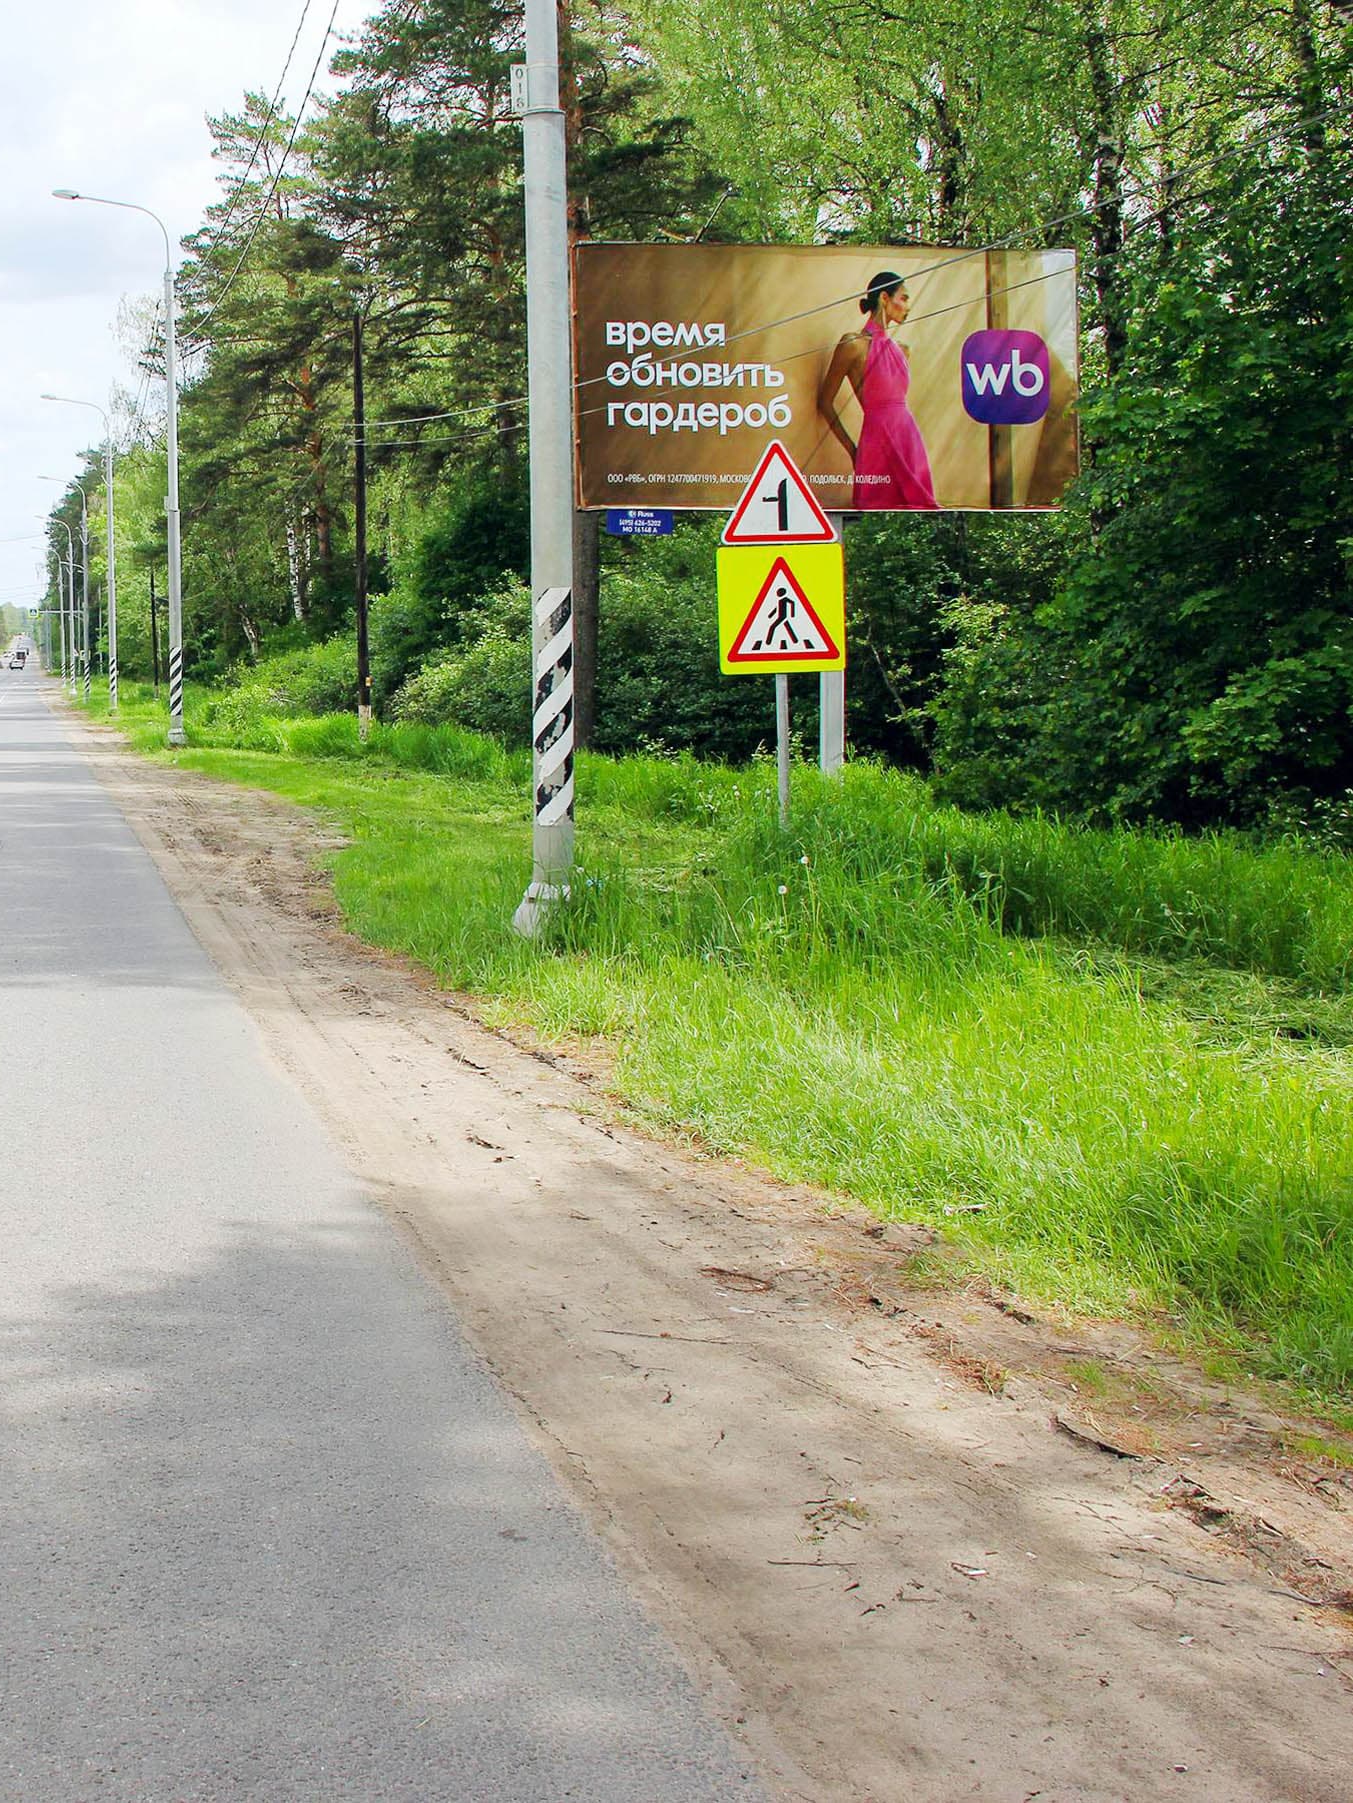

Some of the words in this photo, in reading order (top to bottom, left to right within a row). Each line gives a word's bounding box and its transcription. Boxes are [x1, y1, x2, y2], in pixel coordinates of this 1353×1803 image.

[605, 321, 726, 354] время
[606, 352, 785, 388] обновить
[965, 349, 1045, 397] wb
[607, 394, 793, 436] гардероб
[607, 473, 624, 483] ООО
[648, 473, 666, 483] ОГРН
